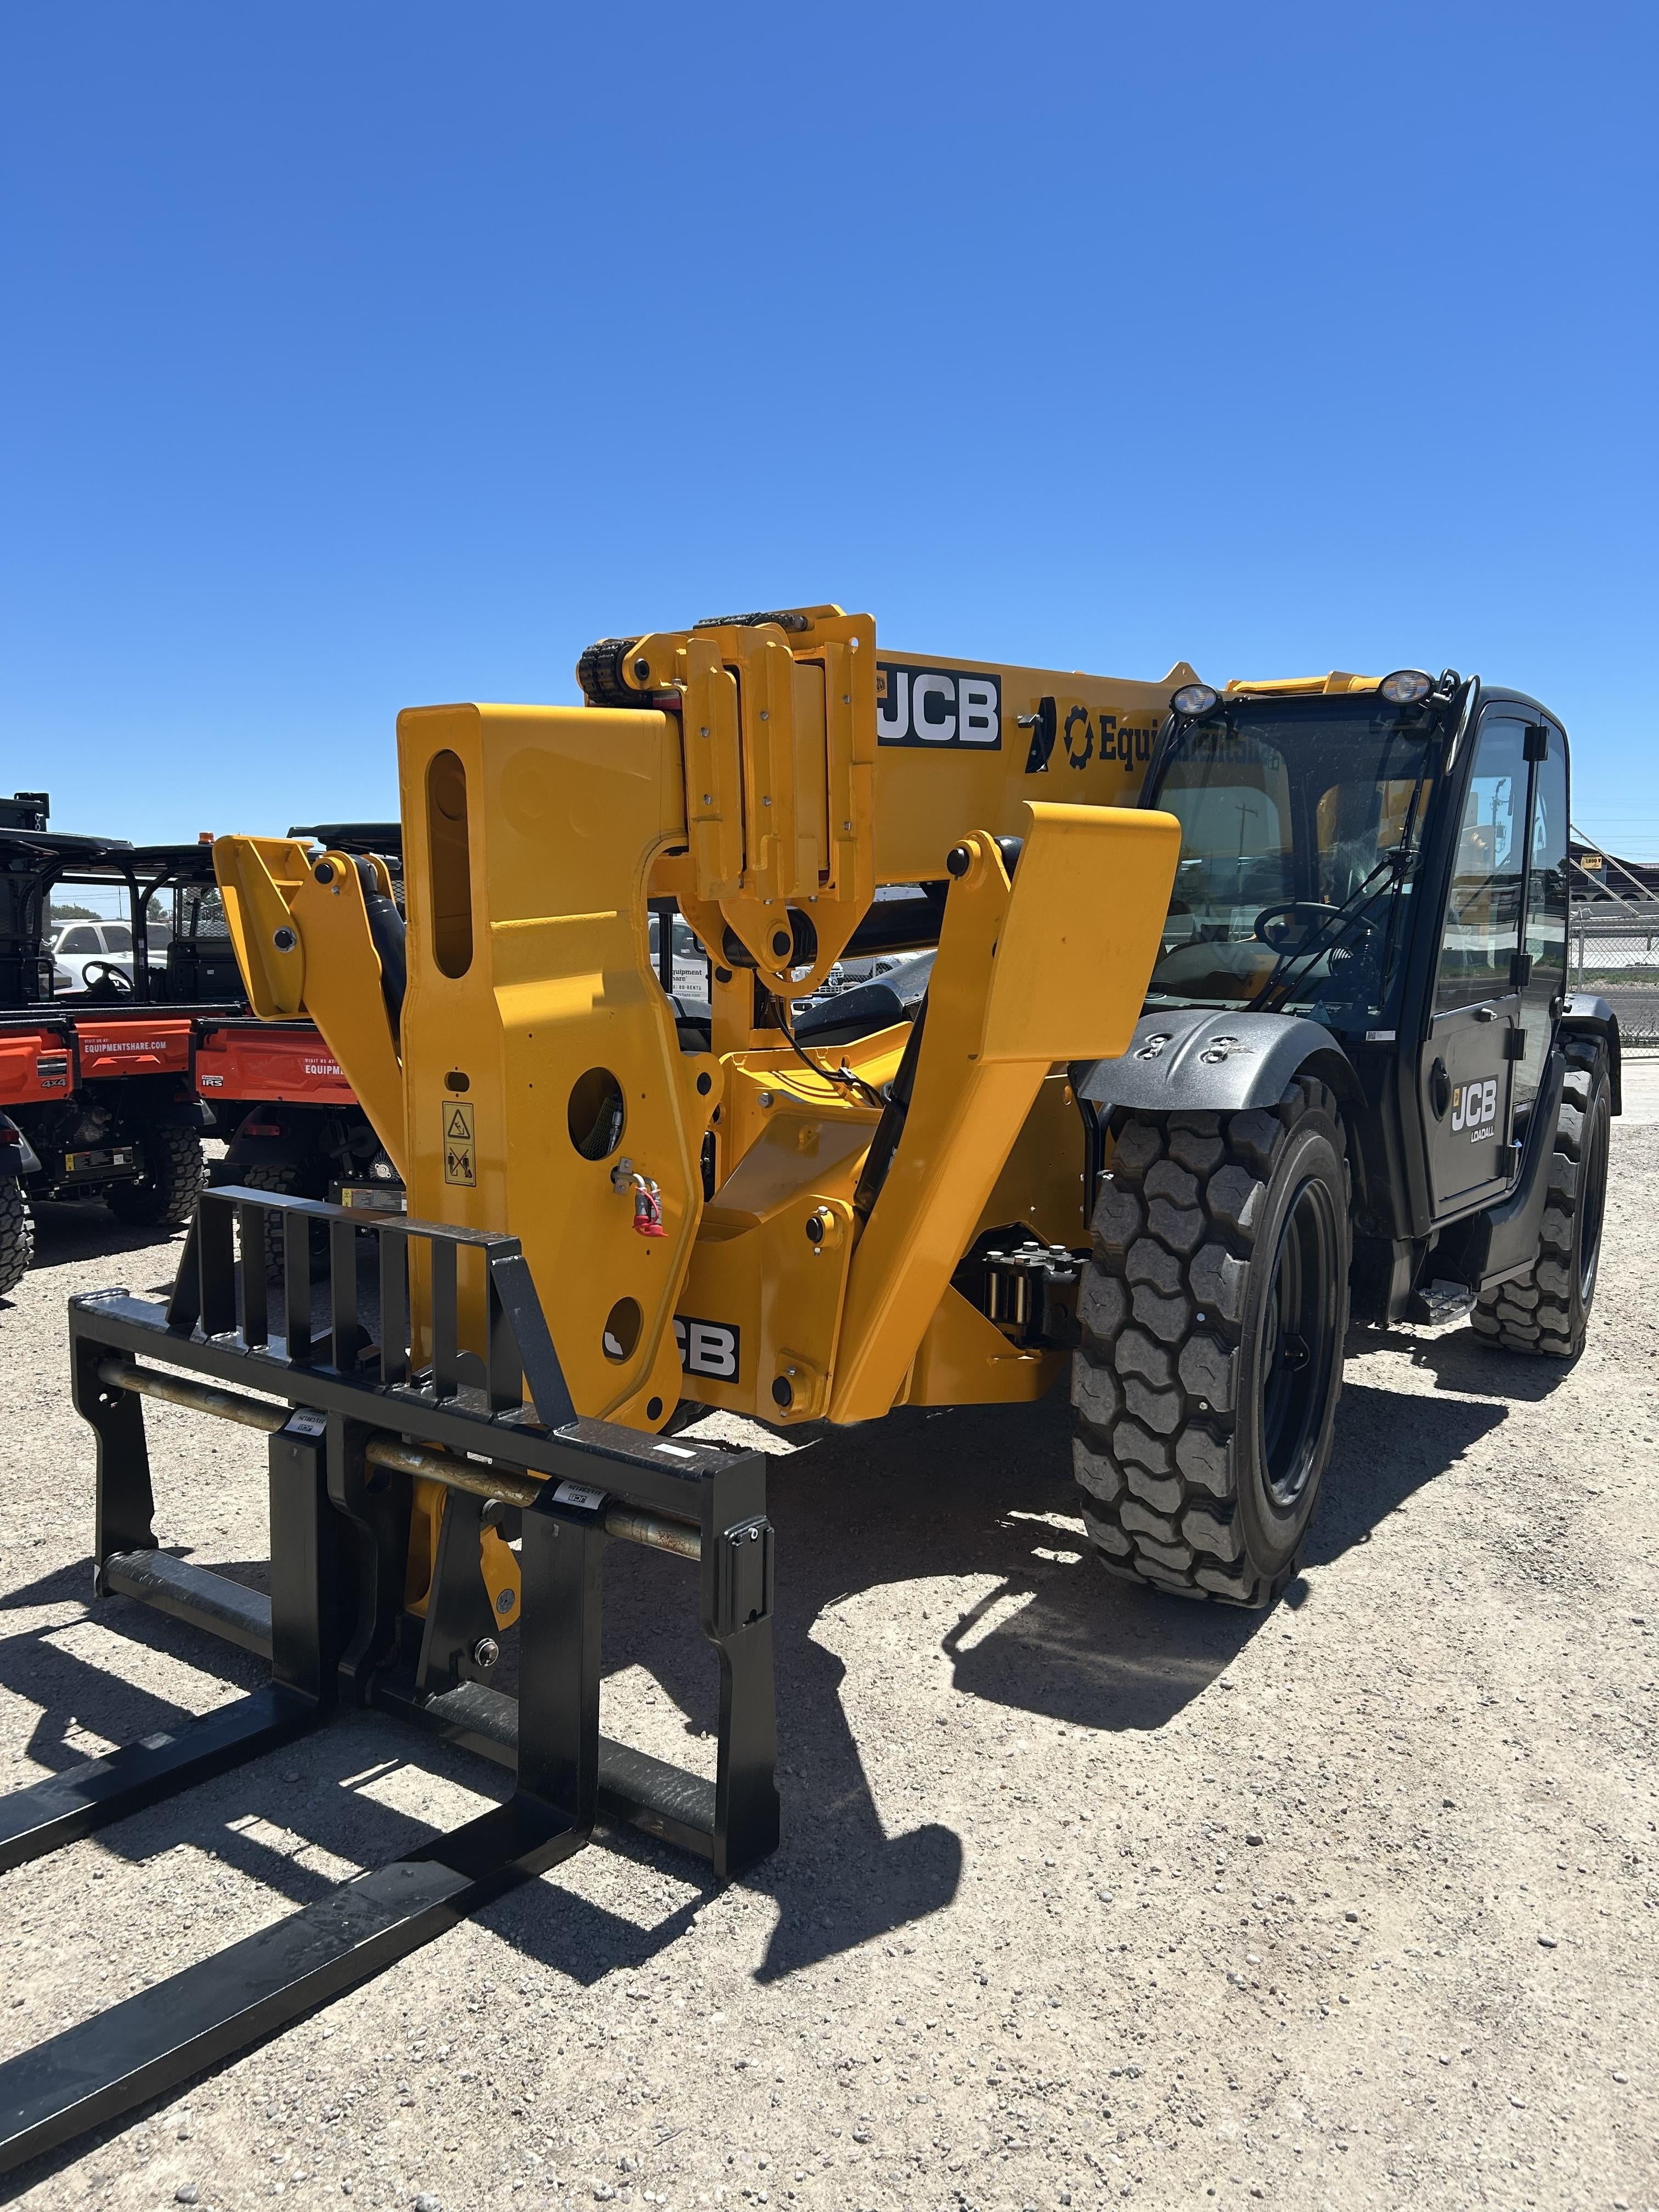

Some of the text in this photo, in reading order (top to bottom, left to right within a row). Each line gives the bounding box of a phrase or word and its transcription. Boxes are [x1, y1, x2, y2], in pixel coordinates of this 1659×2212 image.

[877, 672, 998, 742] JCB
[1099, 715, 1159, 771] Equi
[84, 1041, 166, 1053] EQUIPMENTSHARE.COM
[1452, 1080, 1497, 1131] JCB
[1471, 1126, 1494, 1143] LOADALL
[569, 1493, 586, 1503] JCB
